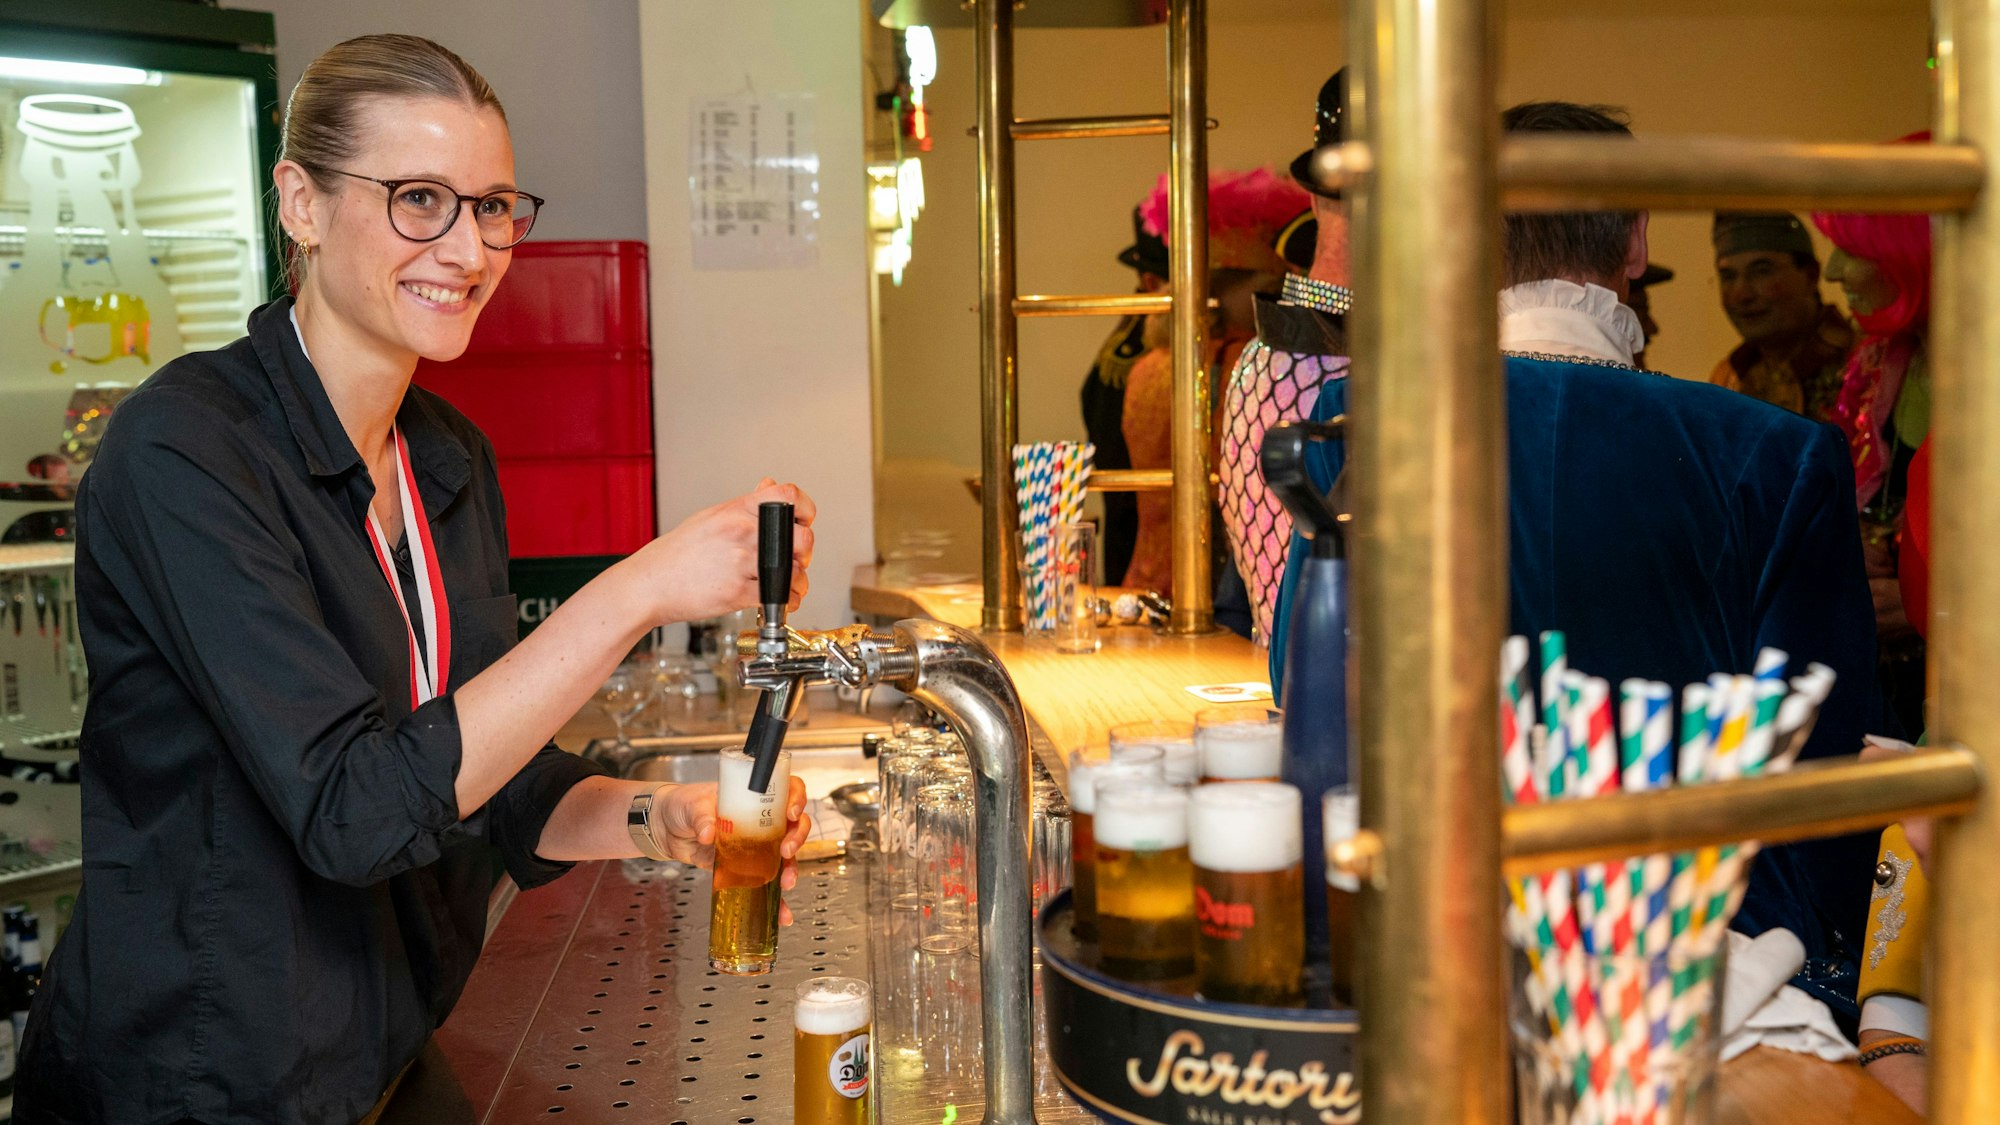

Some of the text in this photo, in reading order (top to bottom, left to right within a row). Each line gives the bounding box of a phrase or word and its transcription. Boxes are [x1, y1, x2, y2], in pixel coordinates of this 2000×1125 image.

[517, 598, 558, 622] CH
[1196, 886, 1254, 928] Dom
[1126, 1030, 1362, 1124] Sartory
